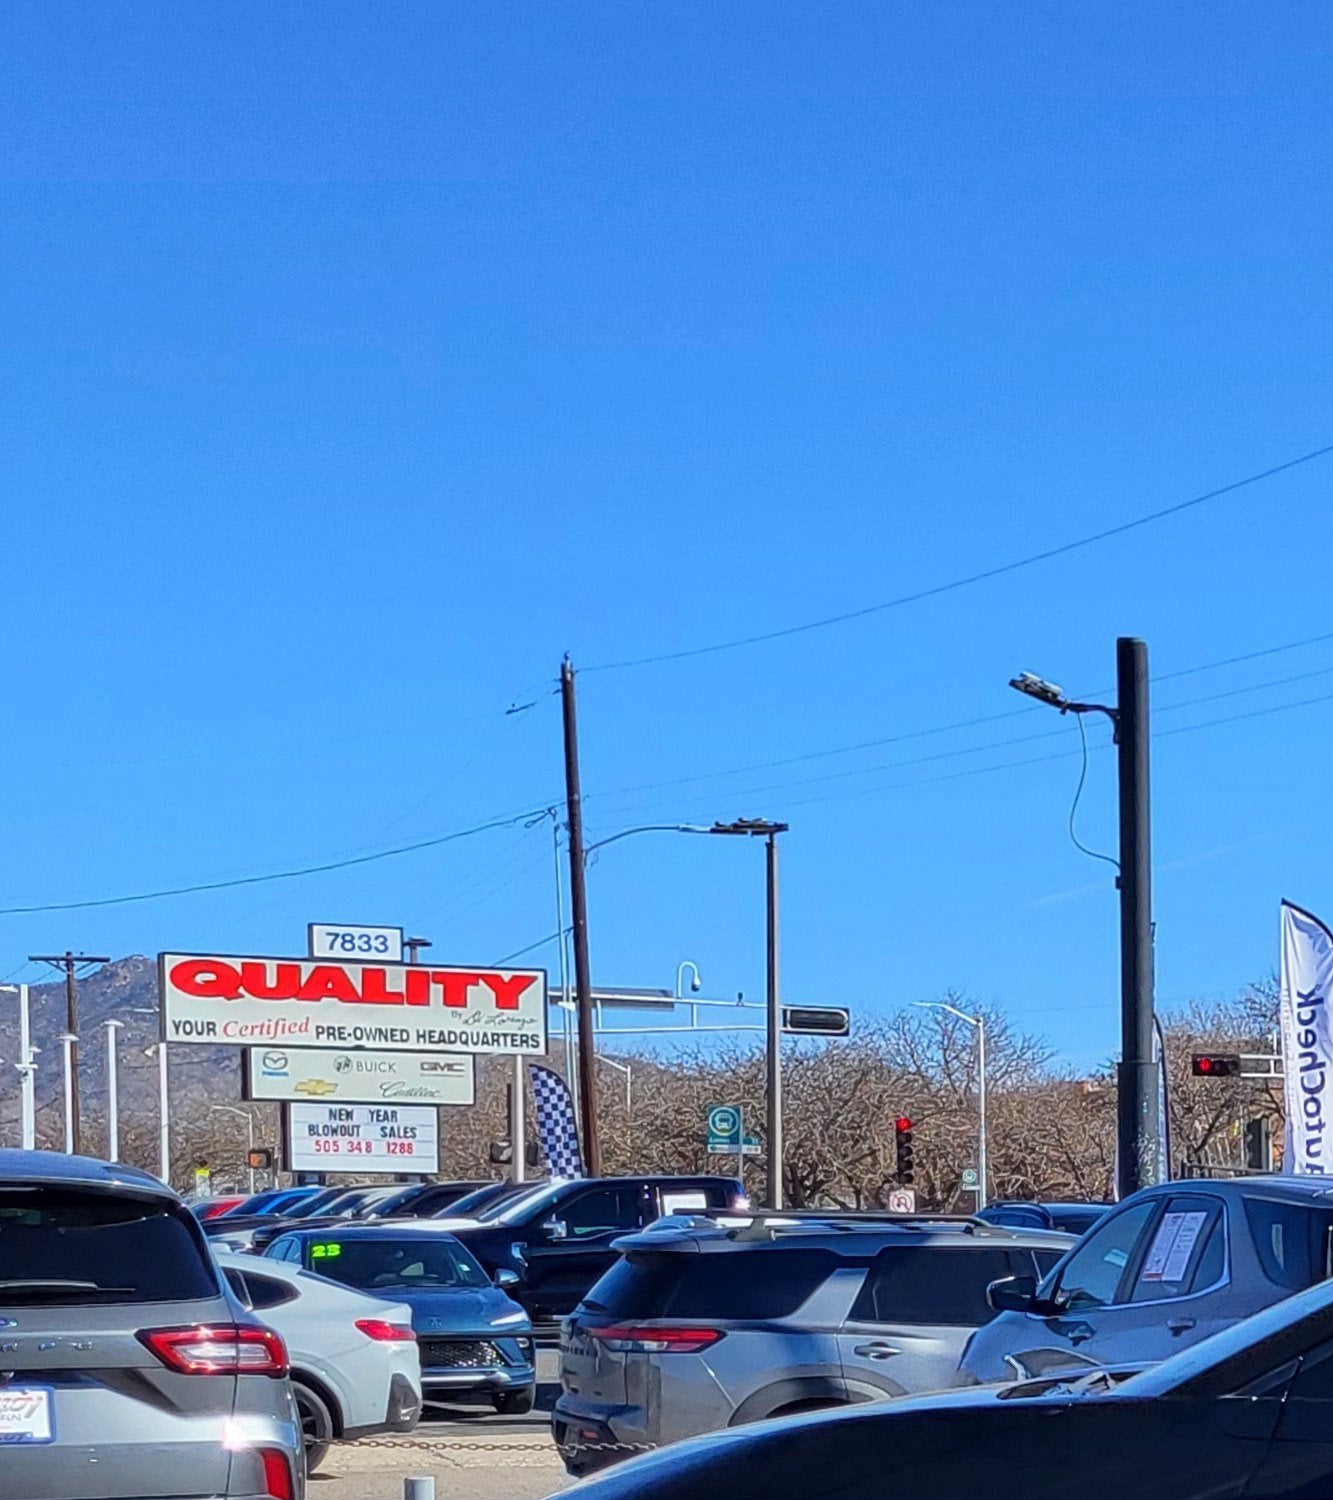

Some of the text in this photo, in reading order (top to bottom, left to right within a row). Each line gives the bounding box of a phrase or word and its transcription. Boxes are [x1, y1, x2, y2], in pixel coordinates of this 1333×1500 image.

[325, 931, 389, 954] 7833
[169, 958, 538, 1011] QUALITY
[172, 1016, 541, 1049] YOUR Certified PRE-OWNED HEADQUARTERS
[356, 1060, 397, 1074] BUICK
[420, 1061, 466, 1073] GMC
[328, 1108, 399, 1123] NEW YEAR
[307, 1124, 418, 1139] BLOWOUT SALES
[314, 1140, 414, 1155] 505 348 1288
